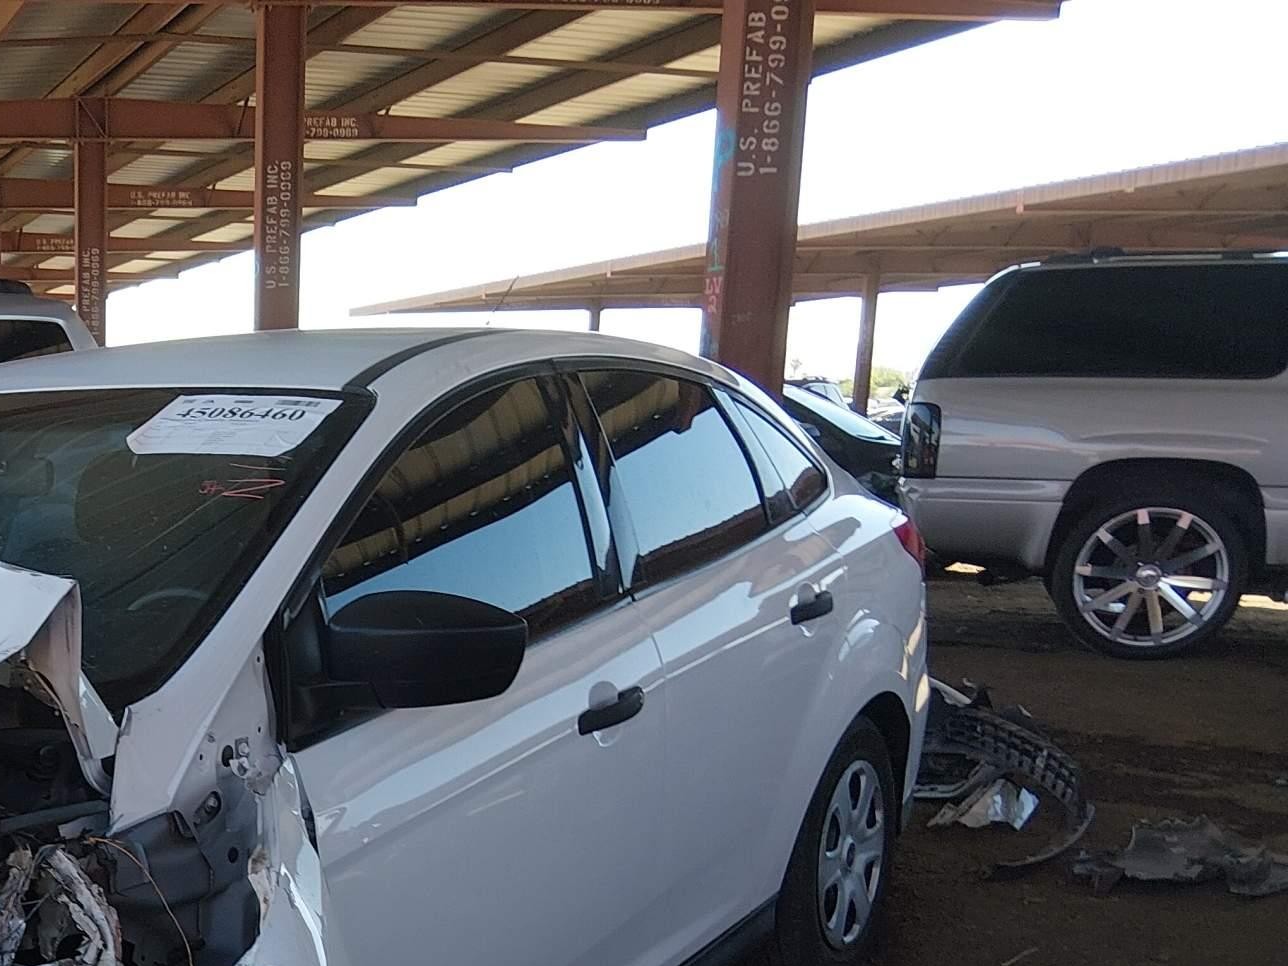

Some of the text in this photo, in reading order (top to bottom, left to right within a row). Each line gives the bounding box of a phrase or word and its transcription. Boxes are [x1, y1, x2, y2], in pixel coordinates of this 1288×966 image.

[737, 11, 767, 176] U.S. PREFAB
[759, 0, 790, 174] 1-866-799-0
[265, 196, 279, 253] PREFAB
[278, 160, 292, 287] 1-866-799-0969
[176, 406, 307, 422] 45086460
